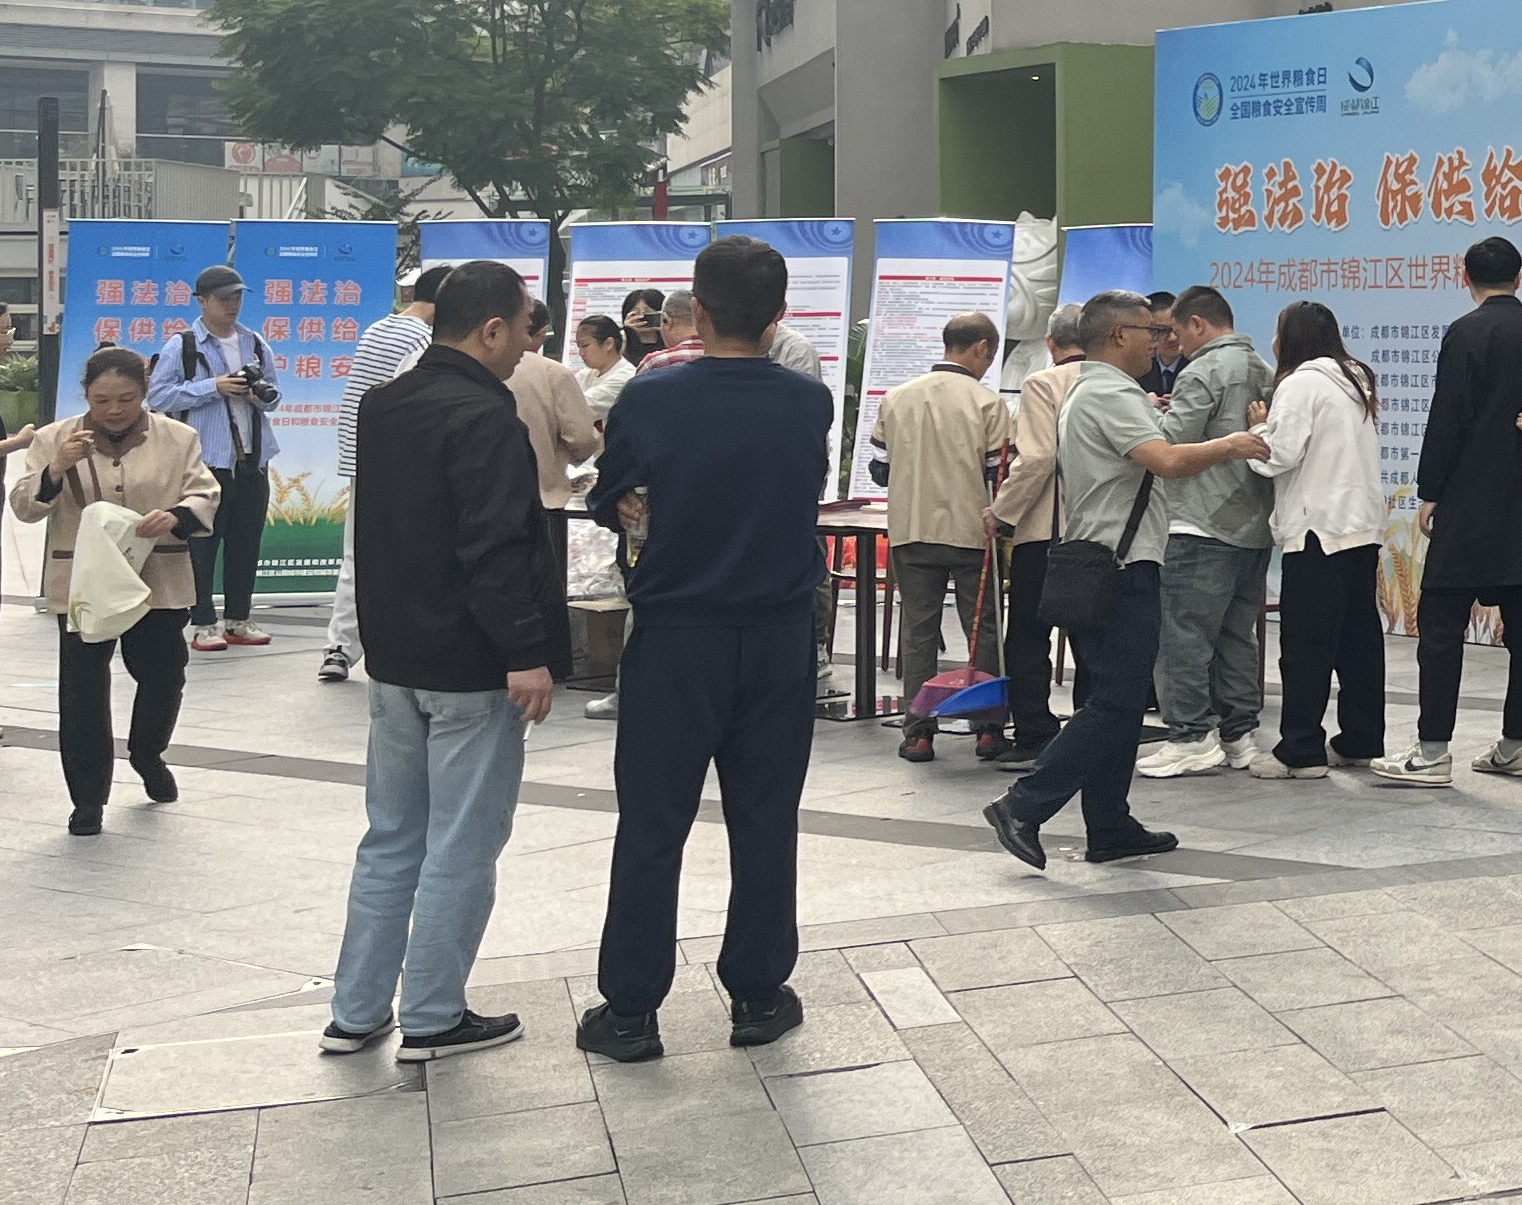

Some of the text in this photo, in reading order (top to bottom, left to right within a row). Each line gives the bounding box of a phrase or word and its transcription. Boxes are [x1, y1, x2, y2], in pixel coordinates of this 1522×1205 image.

[1230, 66, 1328, 93] 2024年世界粮食日
[1229, 94, 1328, 121] 全国粮食安全宣传周
[1215, 158, 1355, 235] 强法治
[96, 279, 193, 306] 强法治
[264, 279, 362, 306] 强法治
[94, 317, 190, 343] 保供给
[262, 317, 359, 342] 保供给
